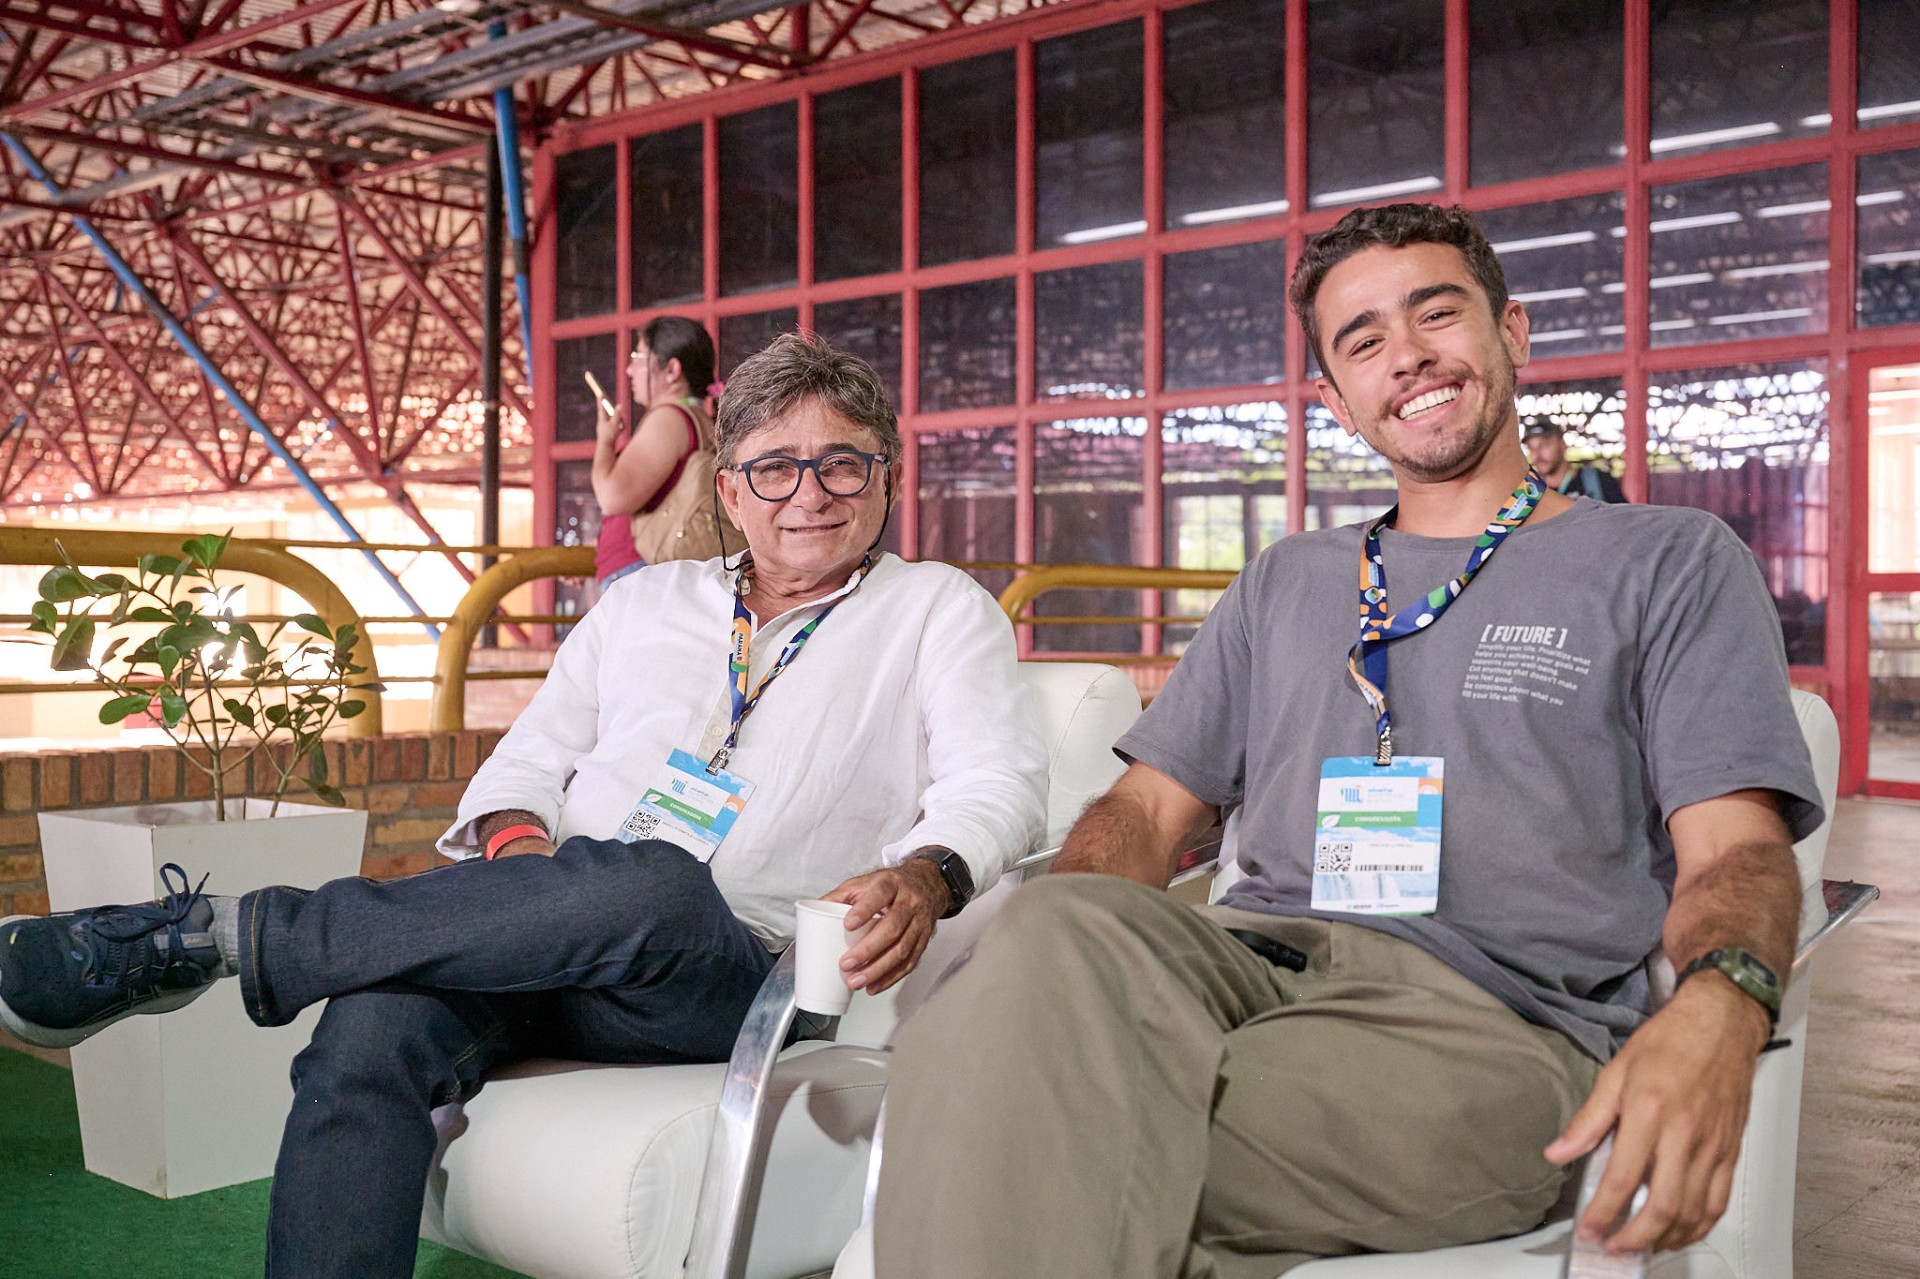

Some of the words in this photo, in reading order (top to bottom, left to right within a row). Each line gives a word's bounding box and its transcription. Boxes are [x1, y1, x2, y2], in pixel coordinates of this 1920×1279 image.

[1491, 625, 1556, 646] FUTURE
[1471, 659, 1502, 667] supports
[1502, 660, 1519, 668] your
[1474, 650, 1493, 658] helps
[1508, 652, 1535, 661] achieve
[1536, 656, 1554, 665] your
[1554, 660, 1574, 670] goals
[1574, 666, 1590, 675] and
[1478, 643, 1506, 652] Simplify
[1538, 646, 1572, 660] Prioritize
[1572, 655, 1591, 666] what
[1465, 674, 1480, 682] you
[1480, 673, 1495, 681] feel
[1481, 666, 1512, 676] anything
[1512, 668, 1529, 677] that
[1529, 671, 1558, 685] doesn't
[1557, 679, 1578, 691] make
[1461, 690, 1472, 698] fill
[1472, 691, 1488, 700] your
[1488, 691, 1501, 701] life
[1464, 681, 1474, 689] Be
[1474, 682, 1508, 692] conscious
[1508, 685, 1530, 696] about
[1529, 690, 1549, 701] what
[1549, 696, 1565, 706] you
